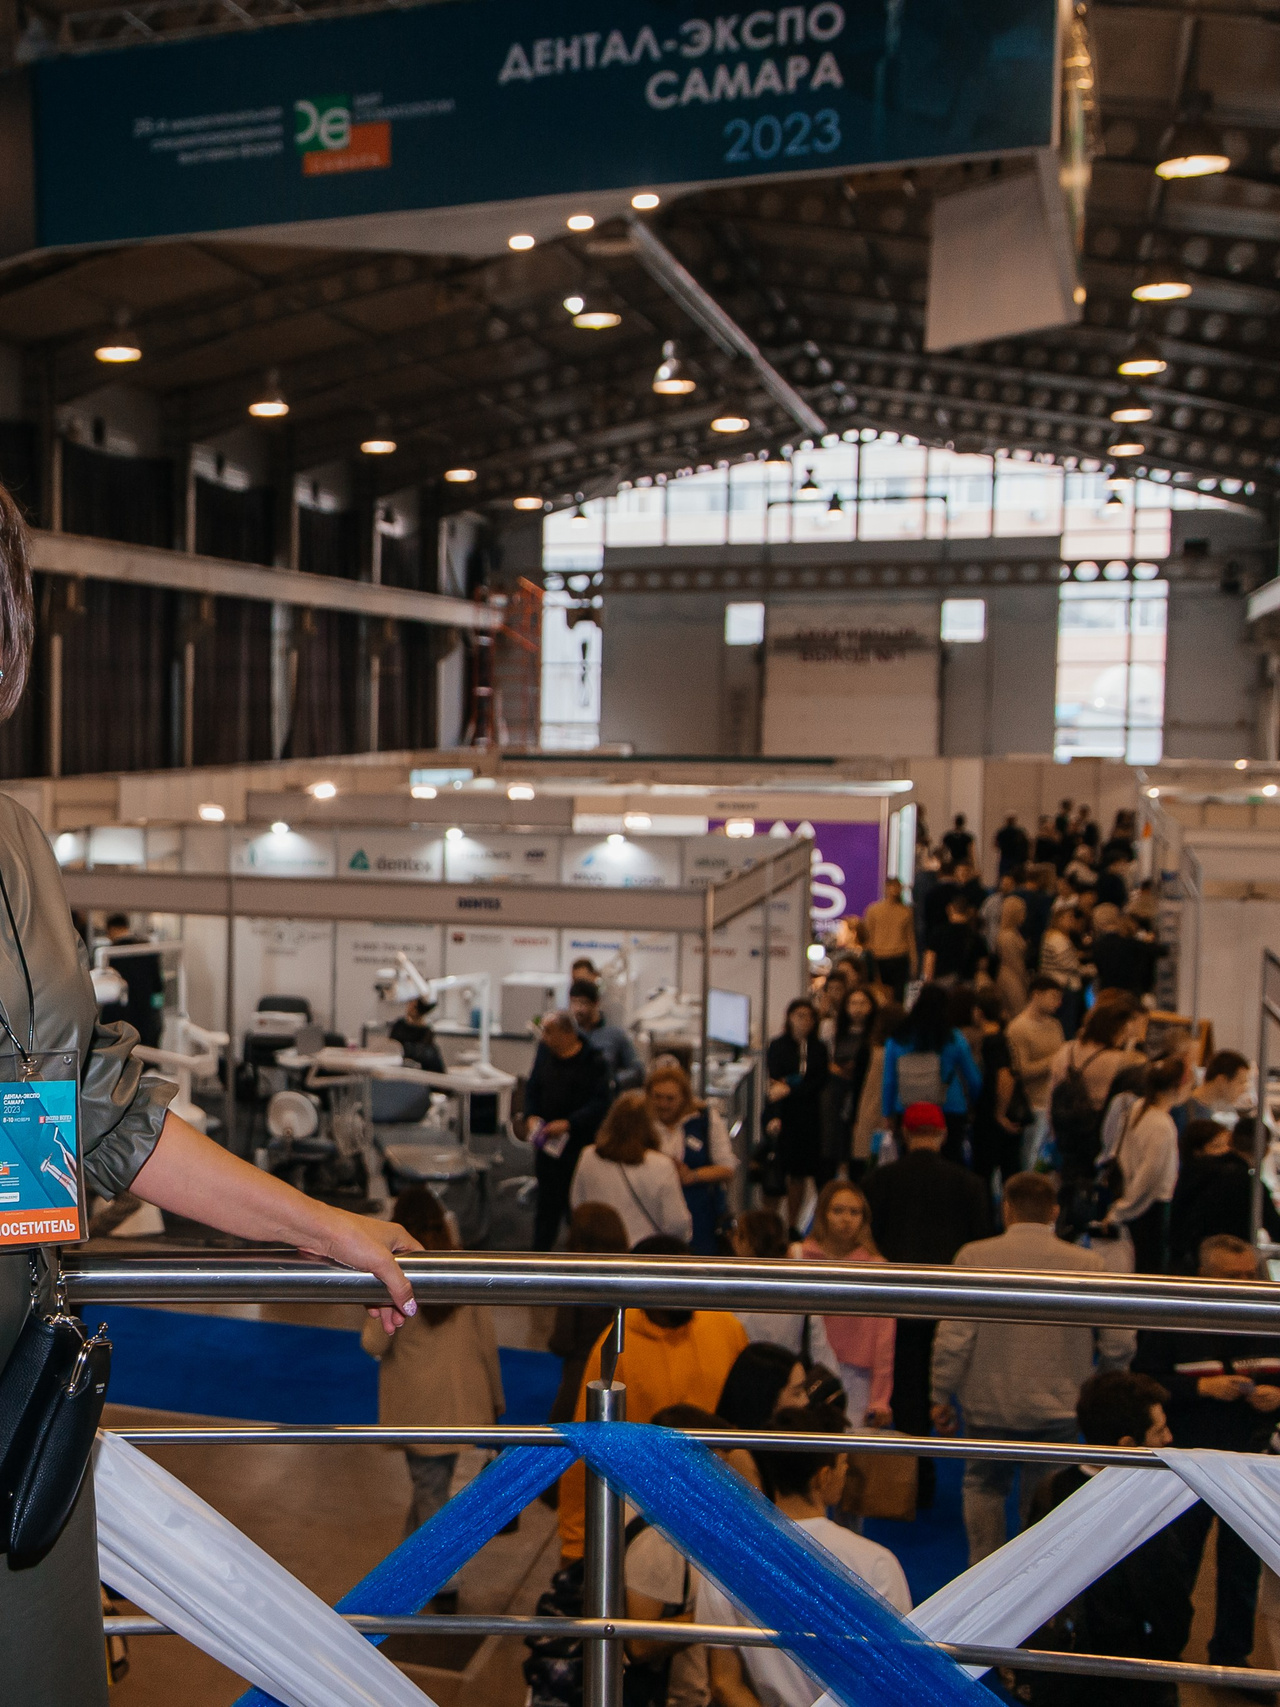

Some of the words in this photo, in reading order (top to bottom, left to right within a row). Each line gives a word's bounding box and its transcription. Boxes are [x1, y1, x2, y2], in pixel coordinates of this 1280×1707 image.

[498, 2, 846, 85] ДЕНТАЛ-ЭКСПО
[645, 51, 844, 110] САМАРА
[723, 108, 842, 163] 2023
[3, 1106, 21, 1114] 2023
